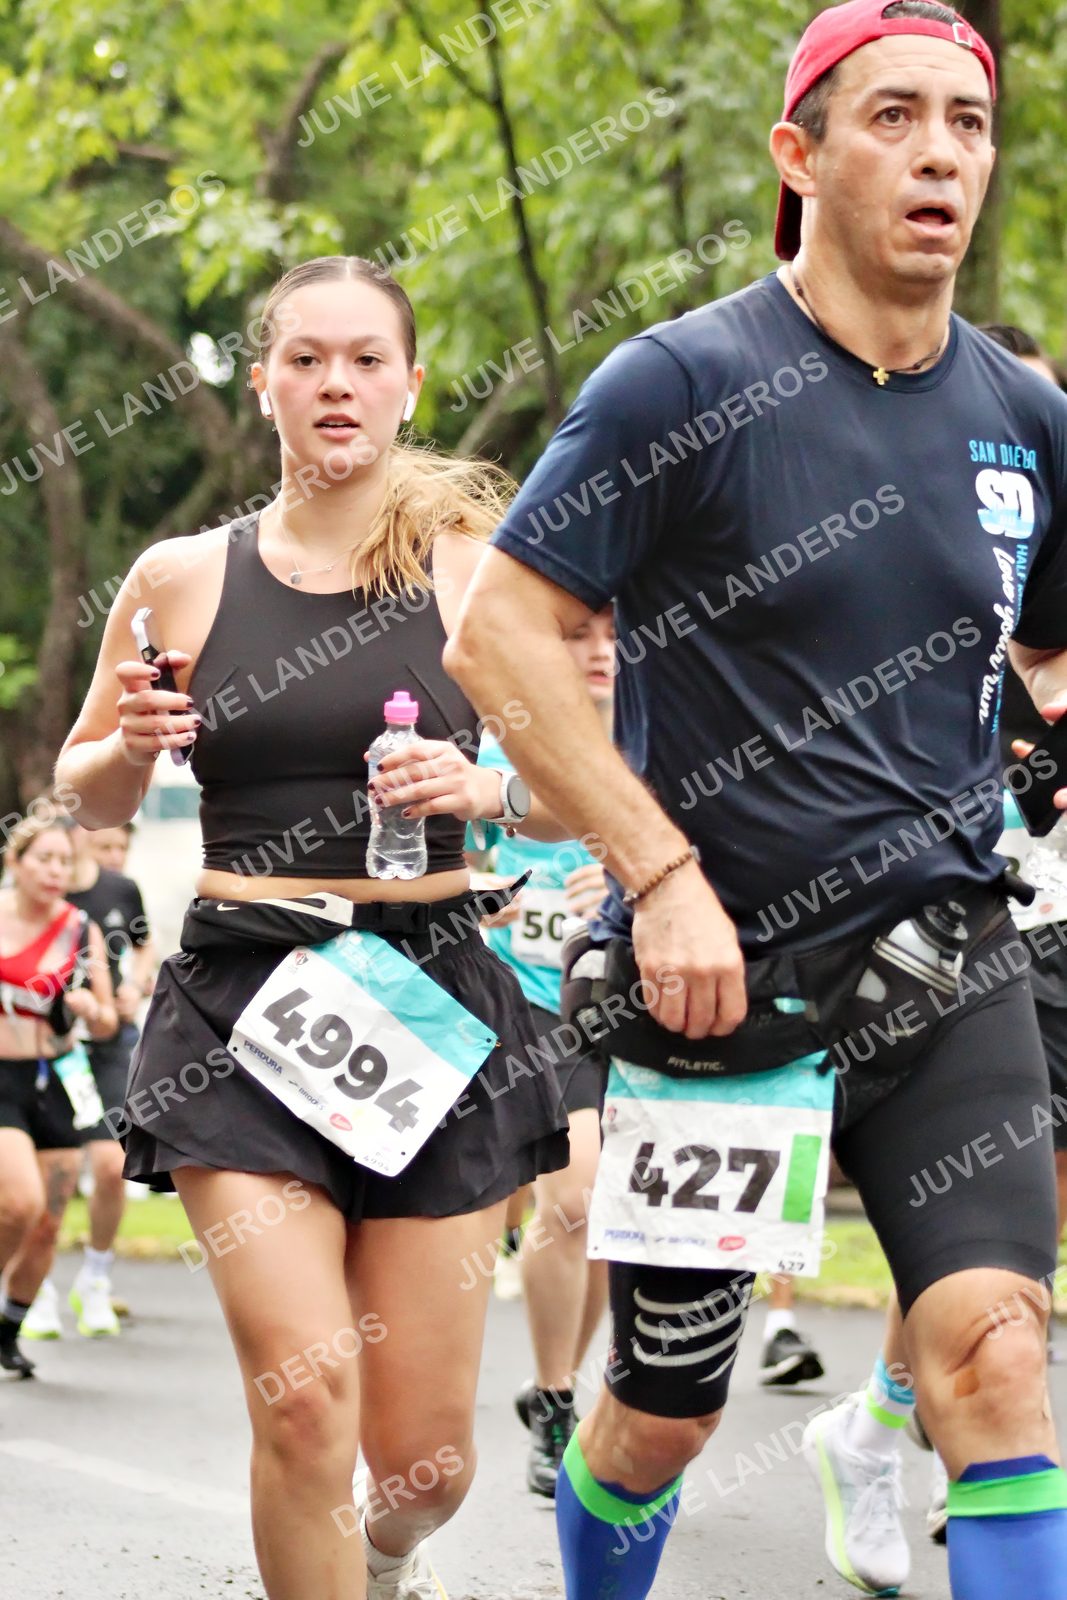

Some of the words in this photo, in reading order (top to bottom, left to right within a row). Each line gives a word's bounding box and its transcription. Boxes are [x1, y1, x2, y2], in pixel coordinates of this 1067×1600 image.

[969, 440, 996, 463] SAN
[244, 1039, 283, 1074] PERDURA
[262, 987, 423, 1134] 4994
[628, 1142, 780, 1213] 427
[778, 1260, 805, 1271] 427
